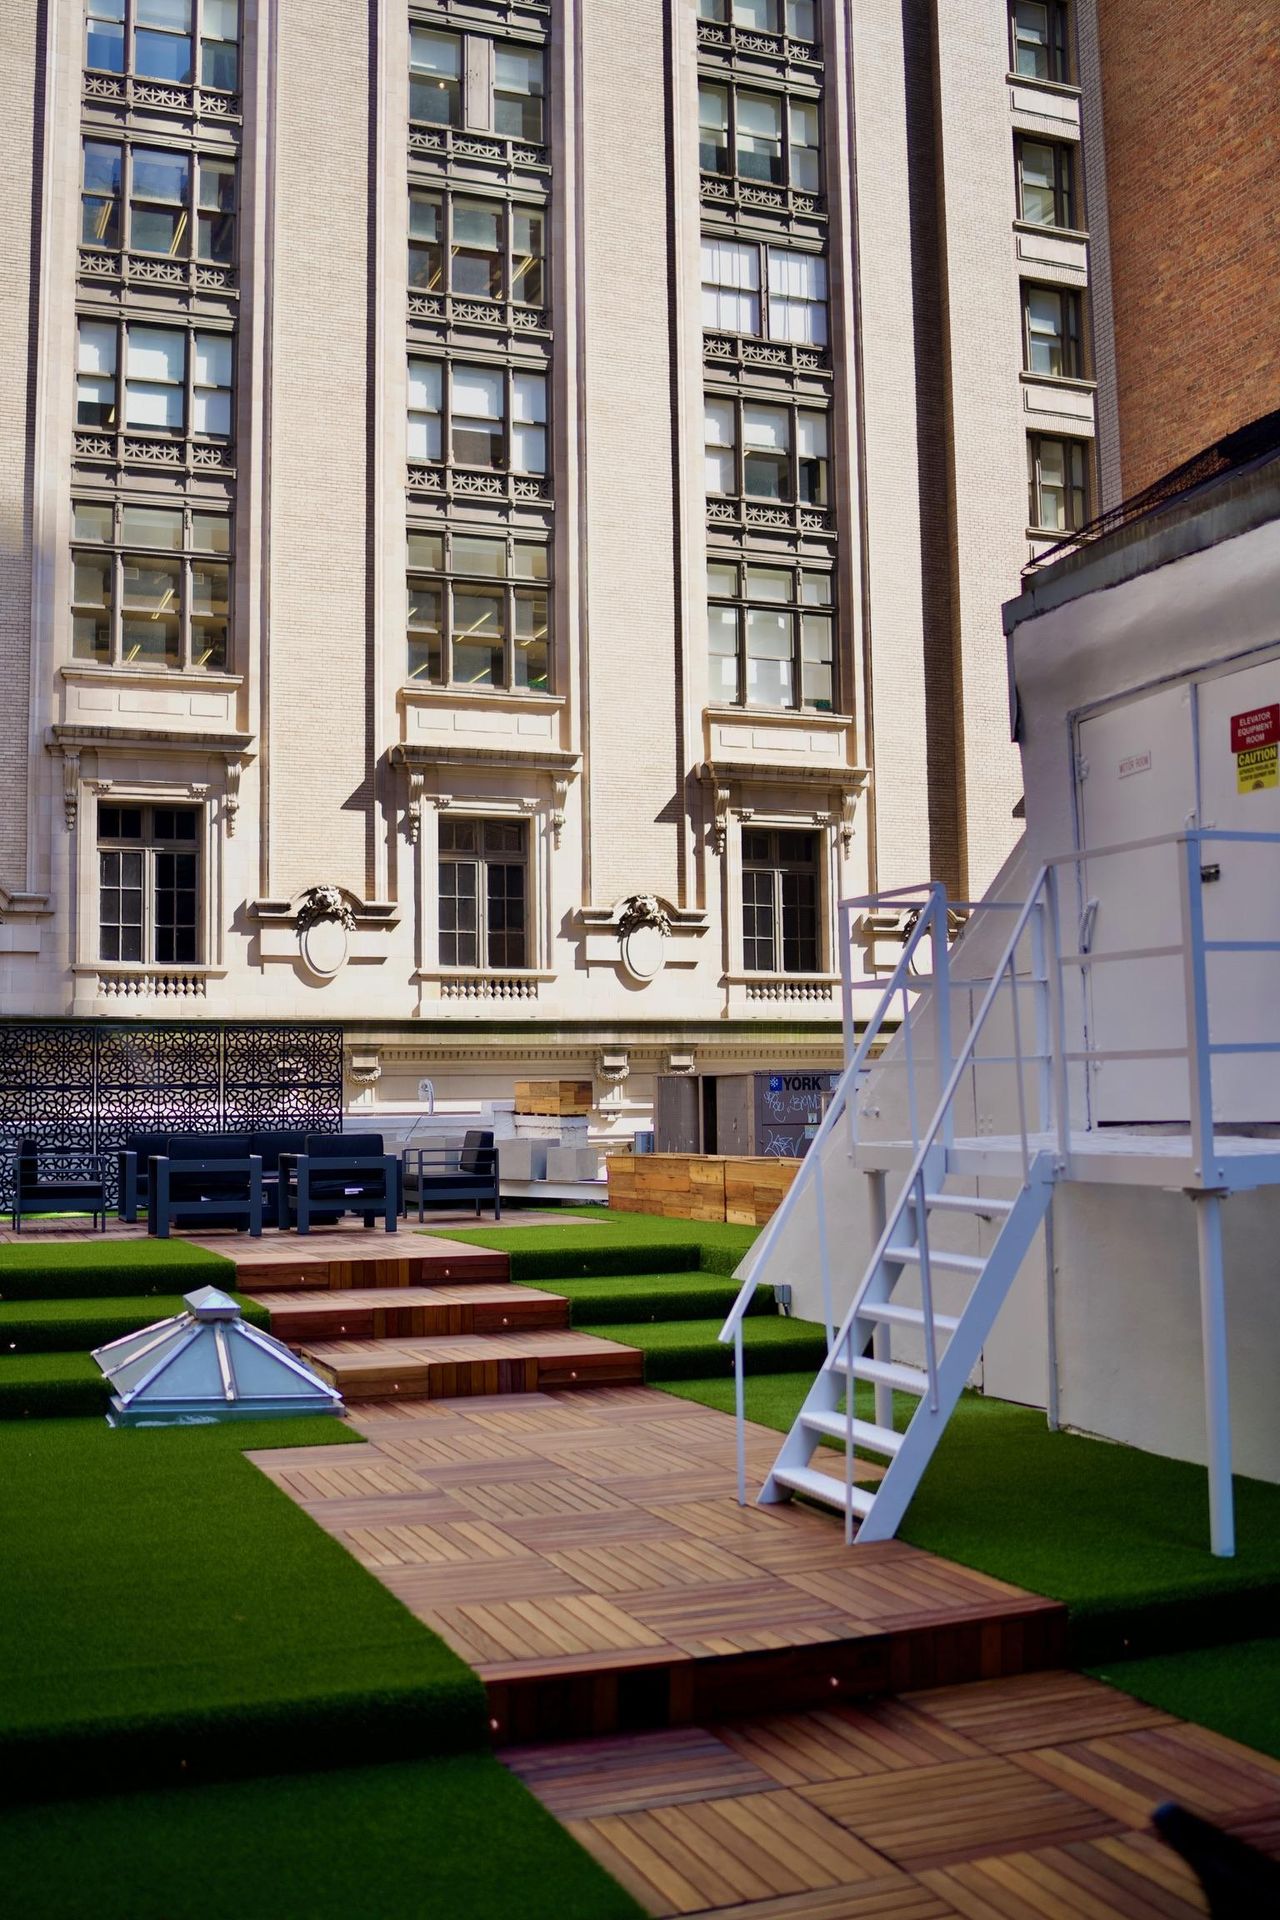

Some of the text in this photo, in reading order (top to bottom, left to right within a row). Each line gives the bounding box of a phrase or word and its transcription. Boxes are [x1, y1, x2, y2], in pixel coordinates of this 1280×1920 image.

[1239, 711, 1271, 726] ELEVATOR
[1237, 720, 1273, 737] EQUIPMENT
[1246, 732, 1265, 744] ROOM
[1135, 755, 1149, 767] ROOM
[1238, 746, 1277, 765] CAUTION
[783, 1076, 822, 1091] YORK
